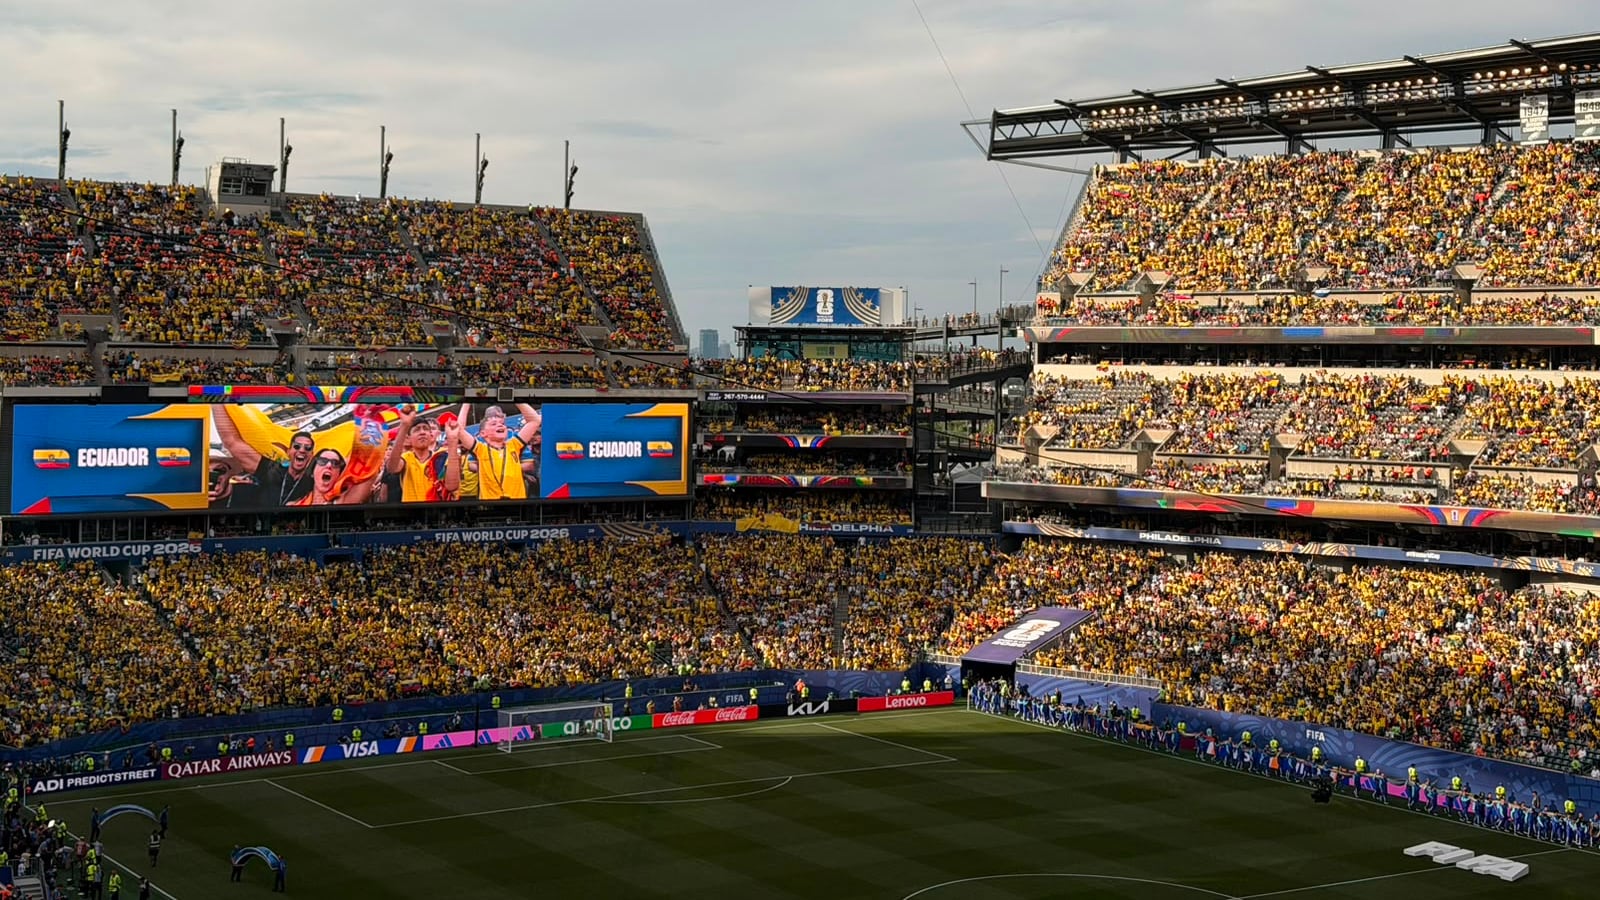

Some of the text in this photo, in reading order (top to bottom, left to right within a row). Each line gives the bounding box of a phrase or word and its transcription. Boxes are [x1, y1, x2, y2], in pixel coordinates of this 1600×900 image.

[1523, 106, 1546, 117] 1947
[77, 447, 149, 467] ECUADOR
[589, 441, 642, 458] ECUADOR
[435, 532, 460, 542] FIFA
[462, 530, 504, 542] WORLD
[505, 529, 529, 540] CUP
[530, 528, 570, 539] 2026
[1138, 532, 1222, 545] PHILADELPHIA
[33, 548, 65, 560] FIFA
[67, 545, 120, 559] WORLD
[122, 544, 151, 556] CUP
[153, 543, 202, 555] 2026
[725, 694, 744, 703] FIFA
[885, 696, 927, 708] Lenovo
[1306, 729, 1326, 741] FIFA
[340, 740, 379, 759] VISA
[167, 751, 292, 778] QATAR AIRWAYS
[32, 768, 157, 793] ADI PREDICTSTREET
[1403, 841, 1530, 882] FIFA
